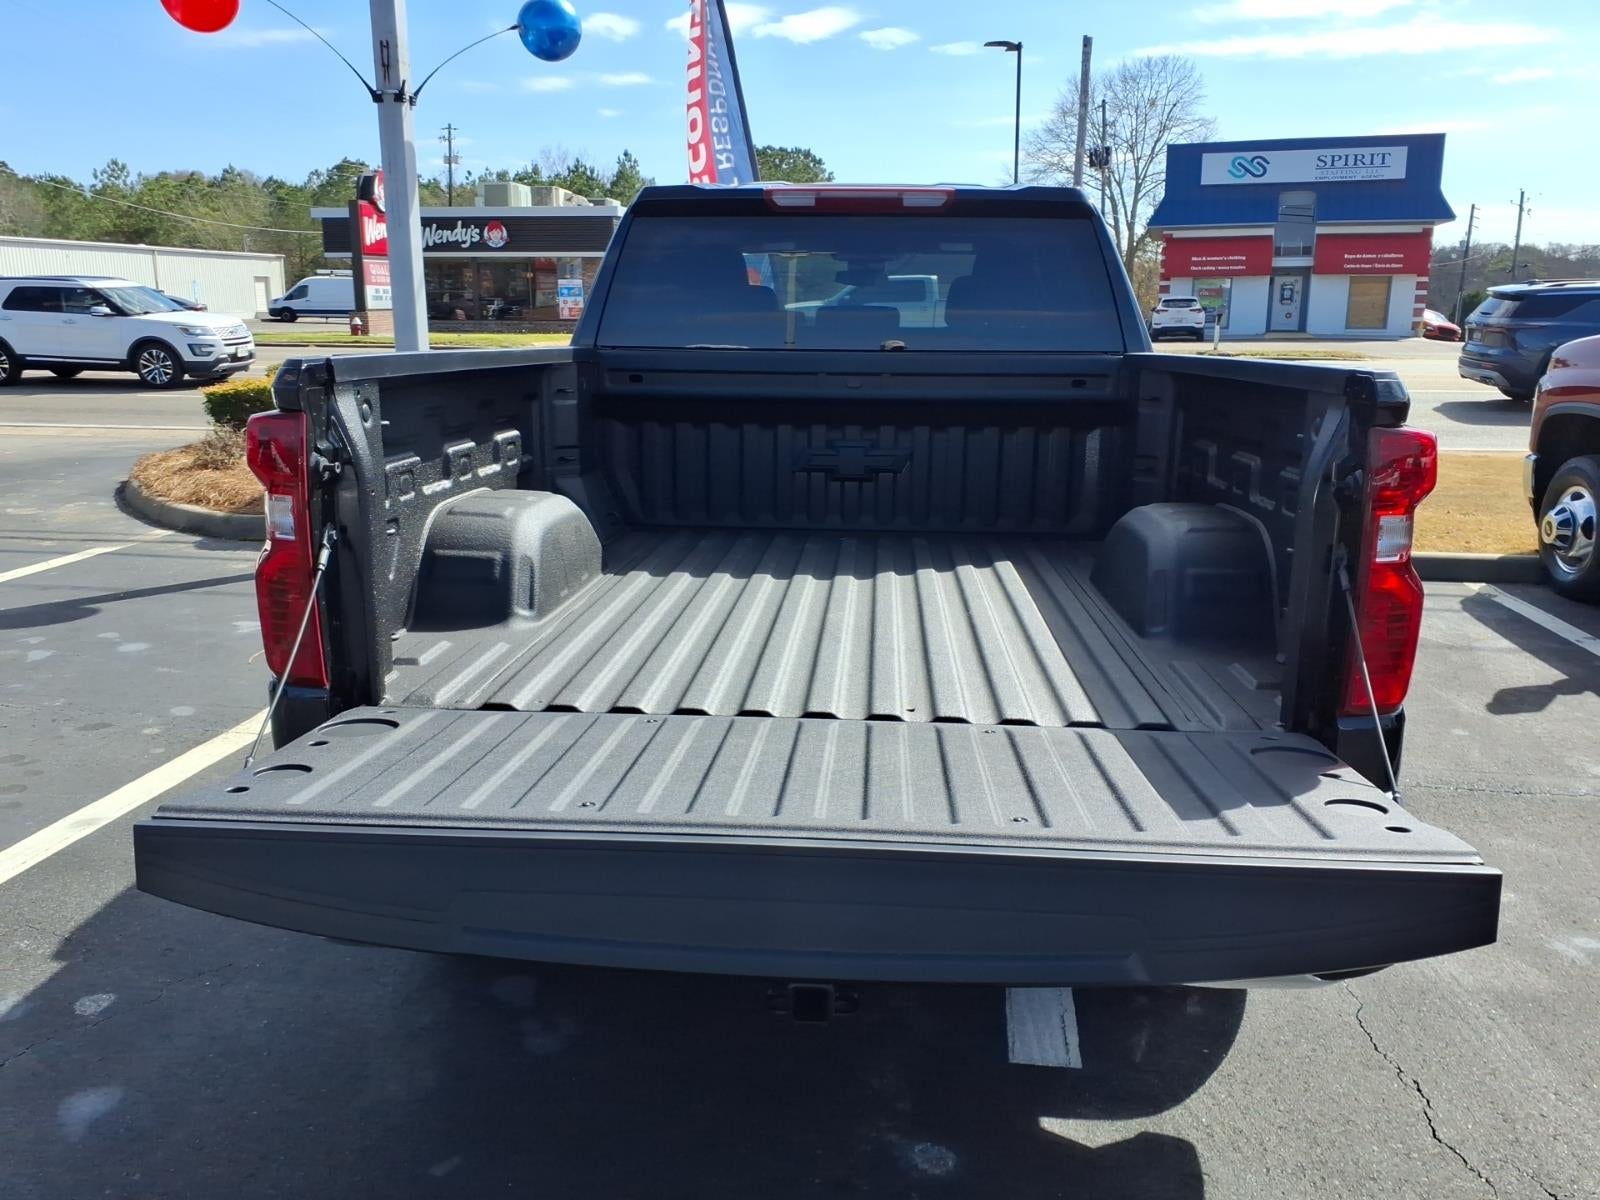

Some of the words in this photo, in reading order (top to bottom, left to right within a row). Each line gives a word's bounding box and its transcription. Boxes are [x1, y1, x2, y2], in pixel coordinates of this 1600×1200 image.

[1316, 152, 1391, 168] SPIRIT
[363, 213, 388, 247] Wen
[421, 220, 481, 248] Wendy's
